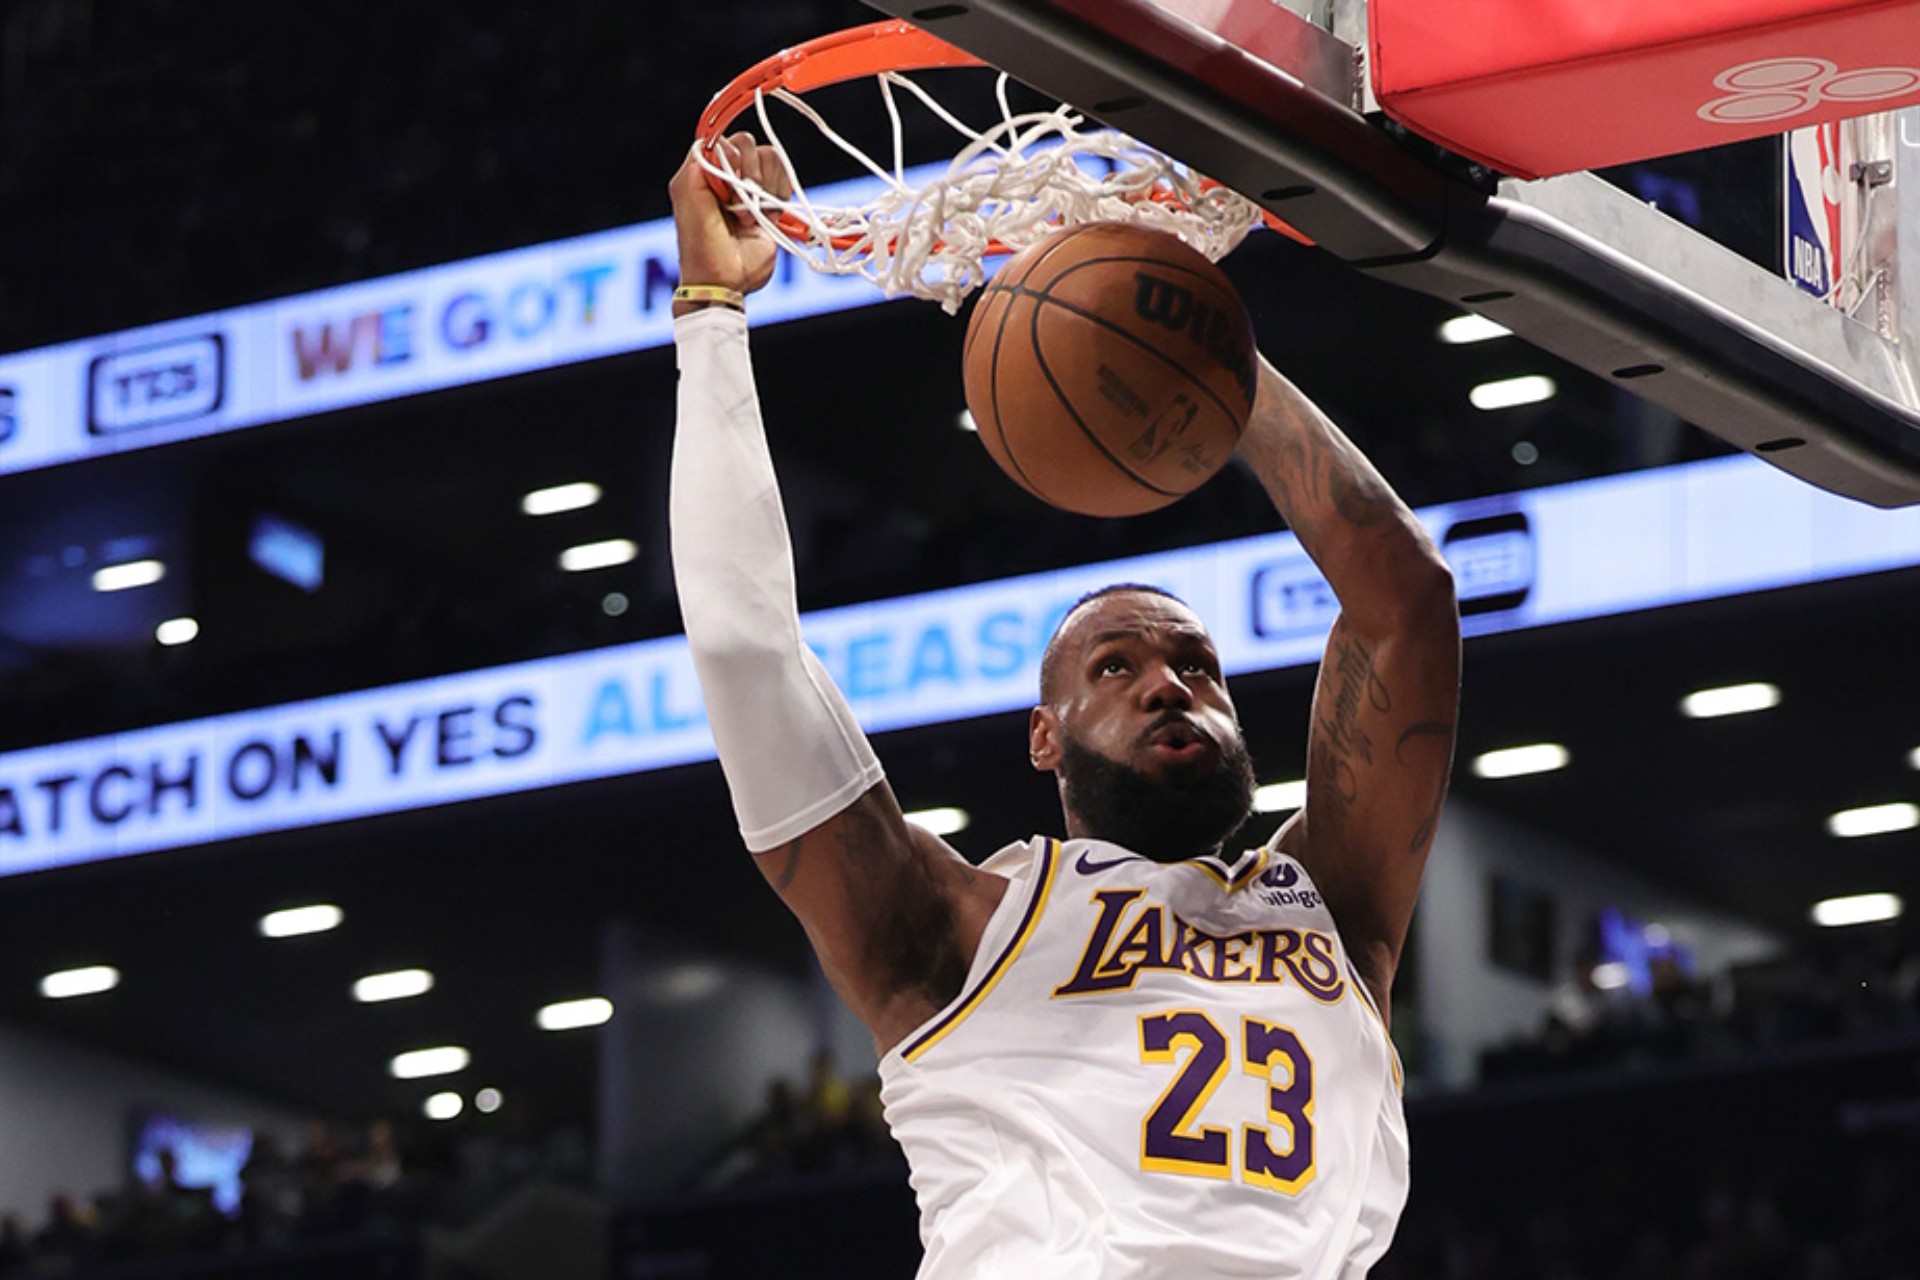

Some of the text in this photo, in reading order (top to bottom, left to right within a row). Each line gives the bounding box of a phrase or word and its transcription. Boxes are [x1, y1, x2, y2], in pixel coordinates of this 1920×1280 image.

[292, 305, 412, 382] WE
[440, 262, 615, 349] GOT
[1793, 235, 1823, 290] NBA
[227, 729, 343, 802] ON
[374, 695, 538, 776] YES
[582, 671, 699, 744] AL
[808, 600, 1071, 700] EAS
[1050, 887, 1345, 1006] LAKERS
[1137, 1007, 1317, 1197] 23
